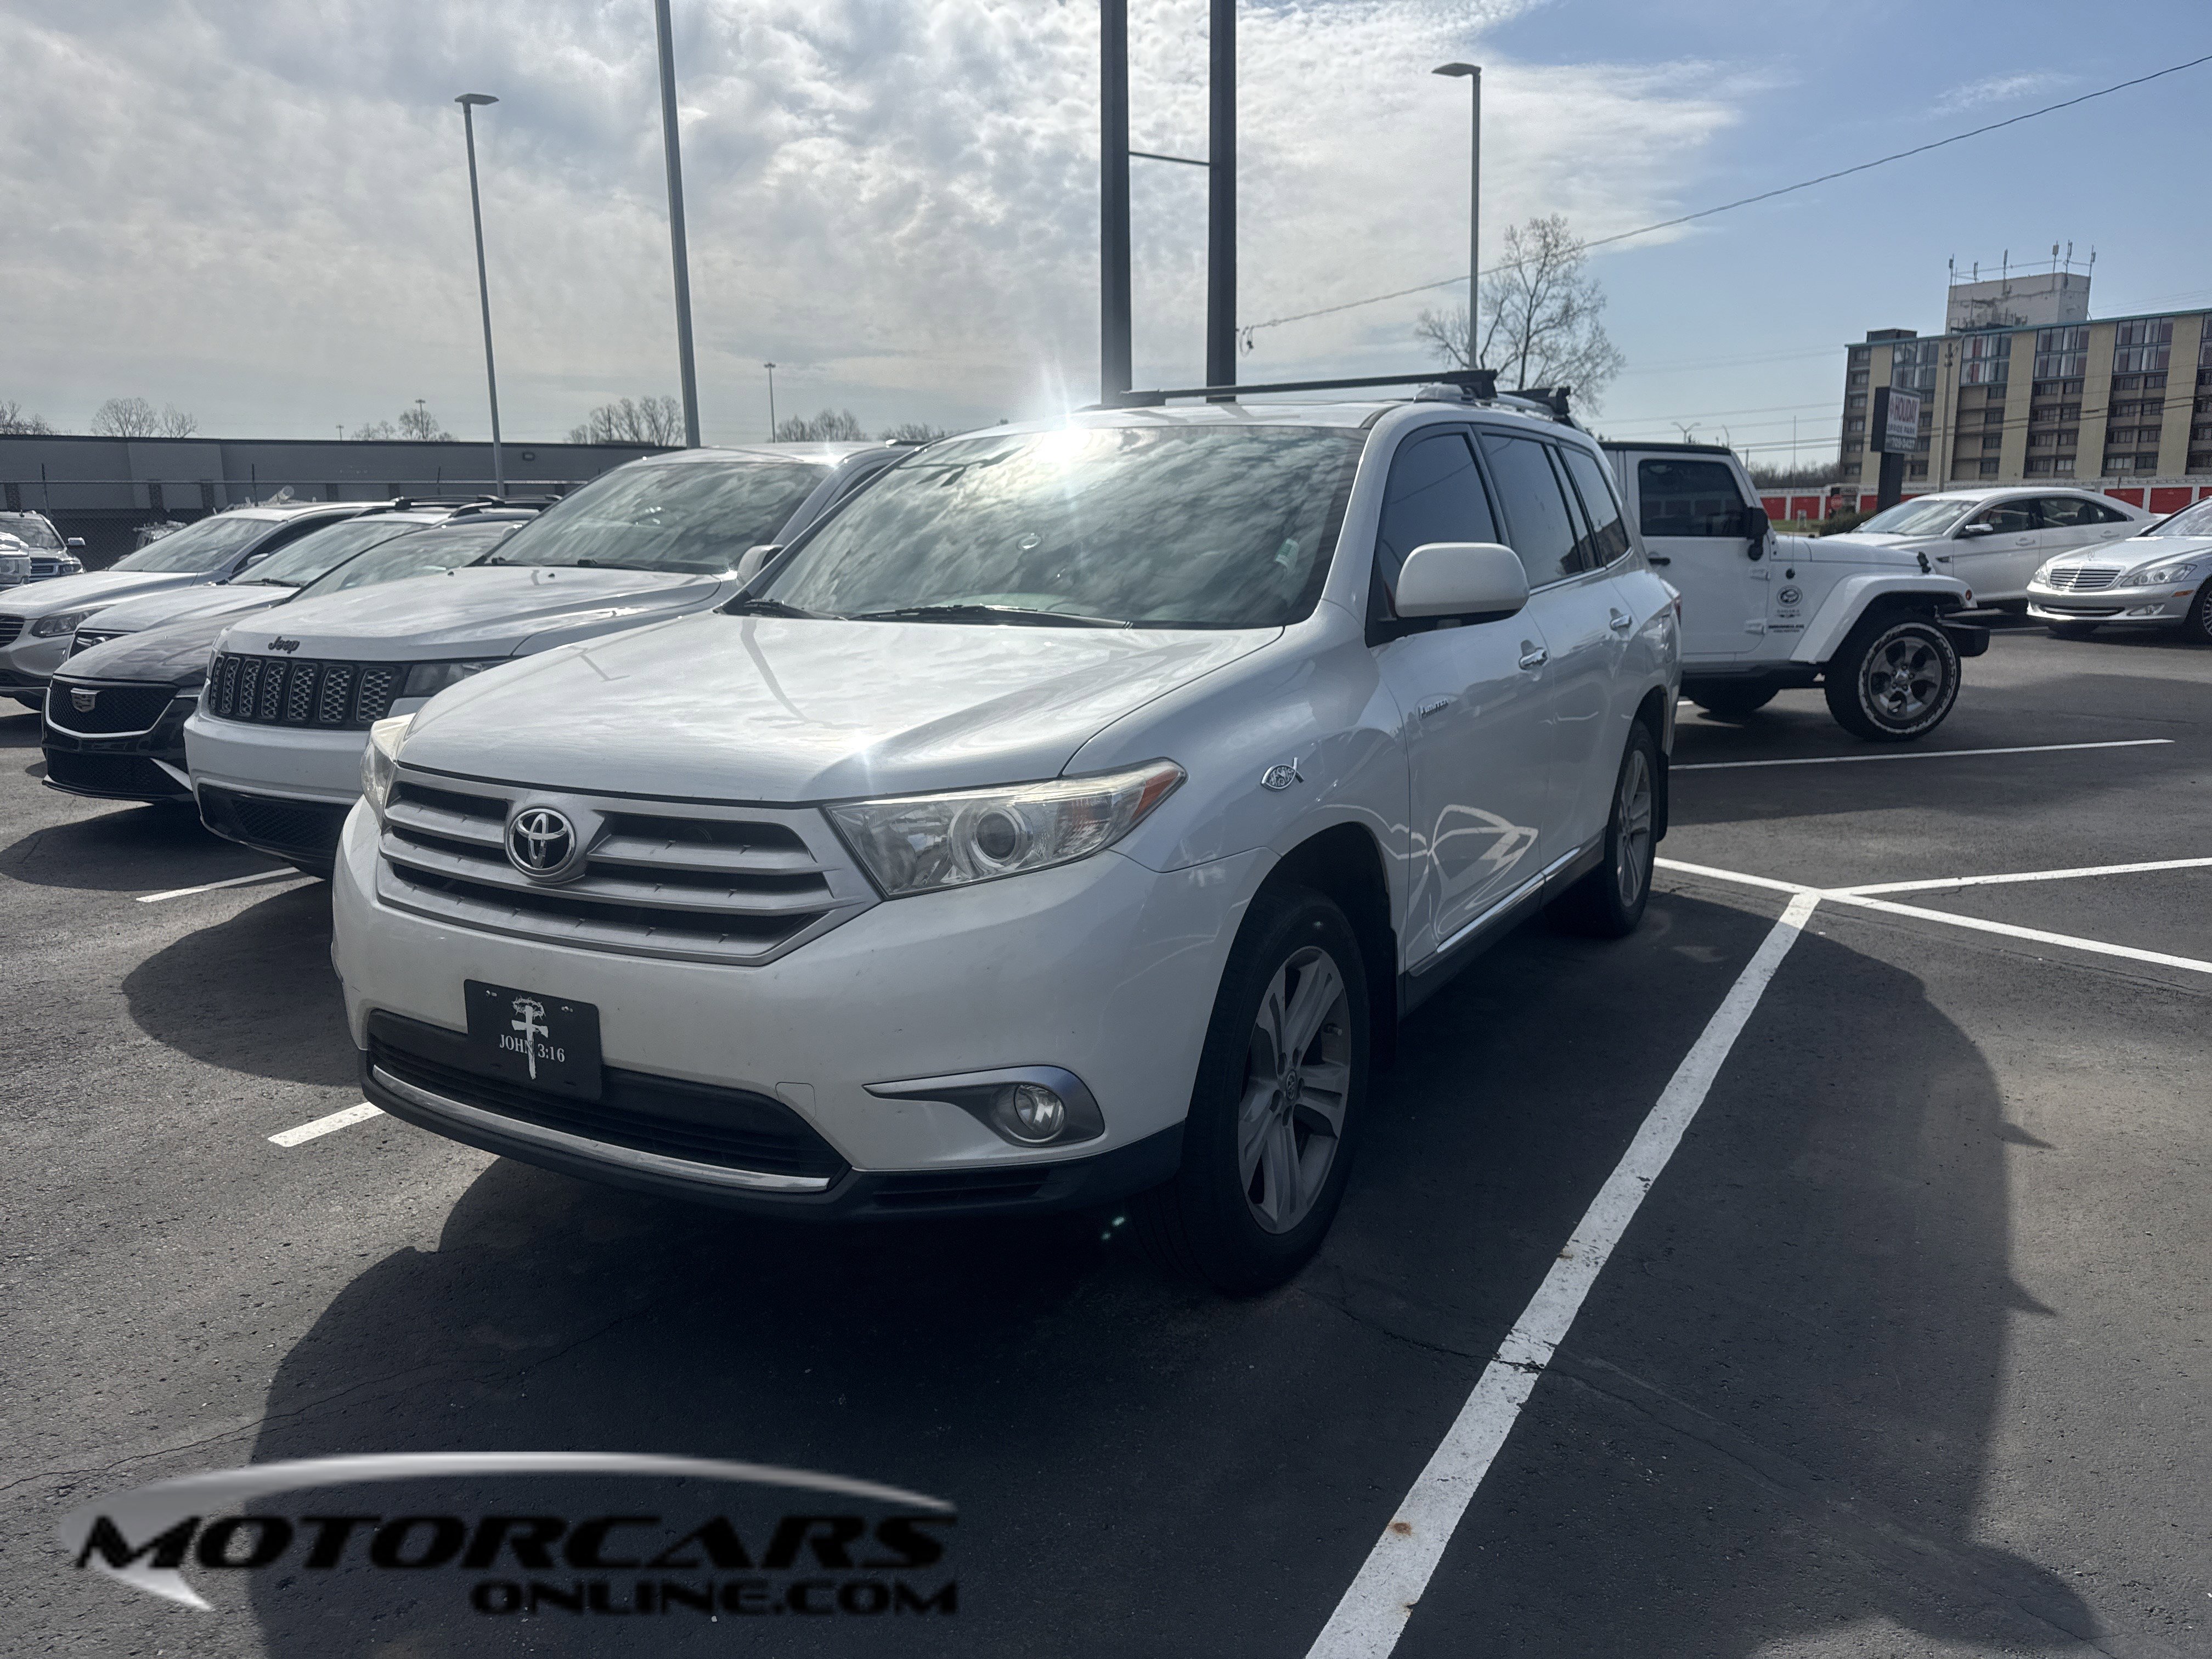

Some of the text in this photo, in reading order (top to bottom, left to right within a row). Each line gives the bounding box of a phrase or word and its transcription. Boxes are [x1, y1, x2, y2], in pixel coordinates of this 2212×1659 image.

[1894, 396, 1918, 424] HOLIDAY
[268, 636, 300, 654] Jeep
[499, 1034, 565, 1063] JOHN 3:16
